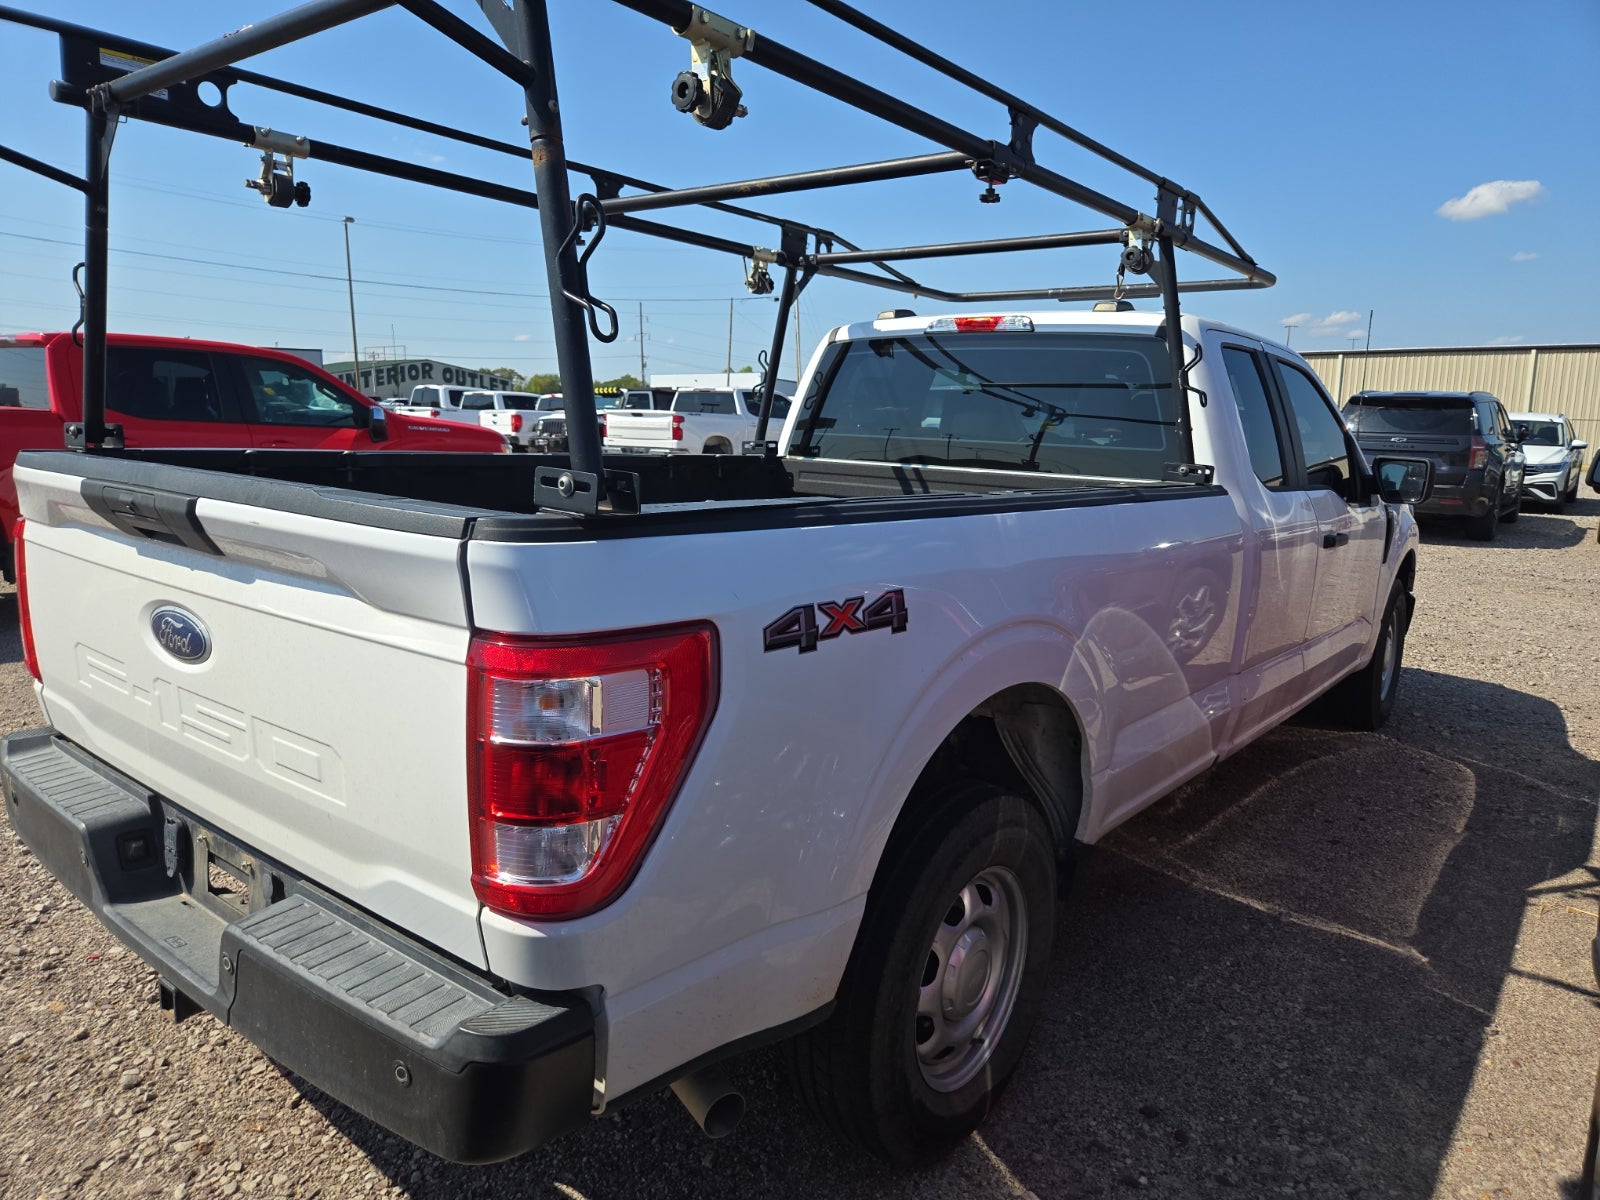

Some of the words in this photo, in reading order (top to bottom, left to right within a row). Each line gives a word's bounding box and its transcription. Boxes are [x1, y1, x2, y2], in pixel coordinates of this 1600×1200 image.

[338, 362, 433, 389] NTERIOR
[442, 367, 509, 391] OUTLET
[160, 617, 192, 653] Ford
[75, 642, 346, 806] F-150
